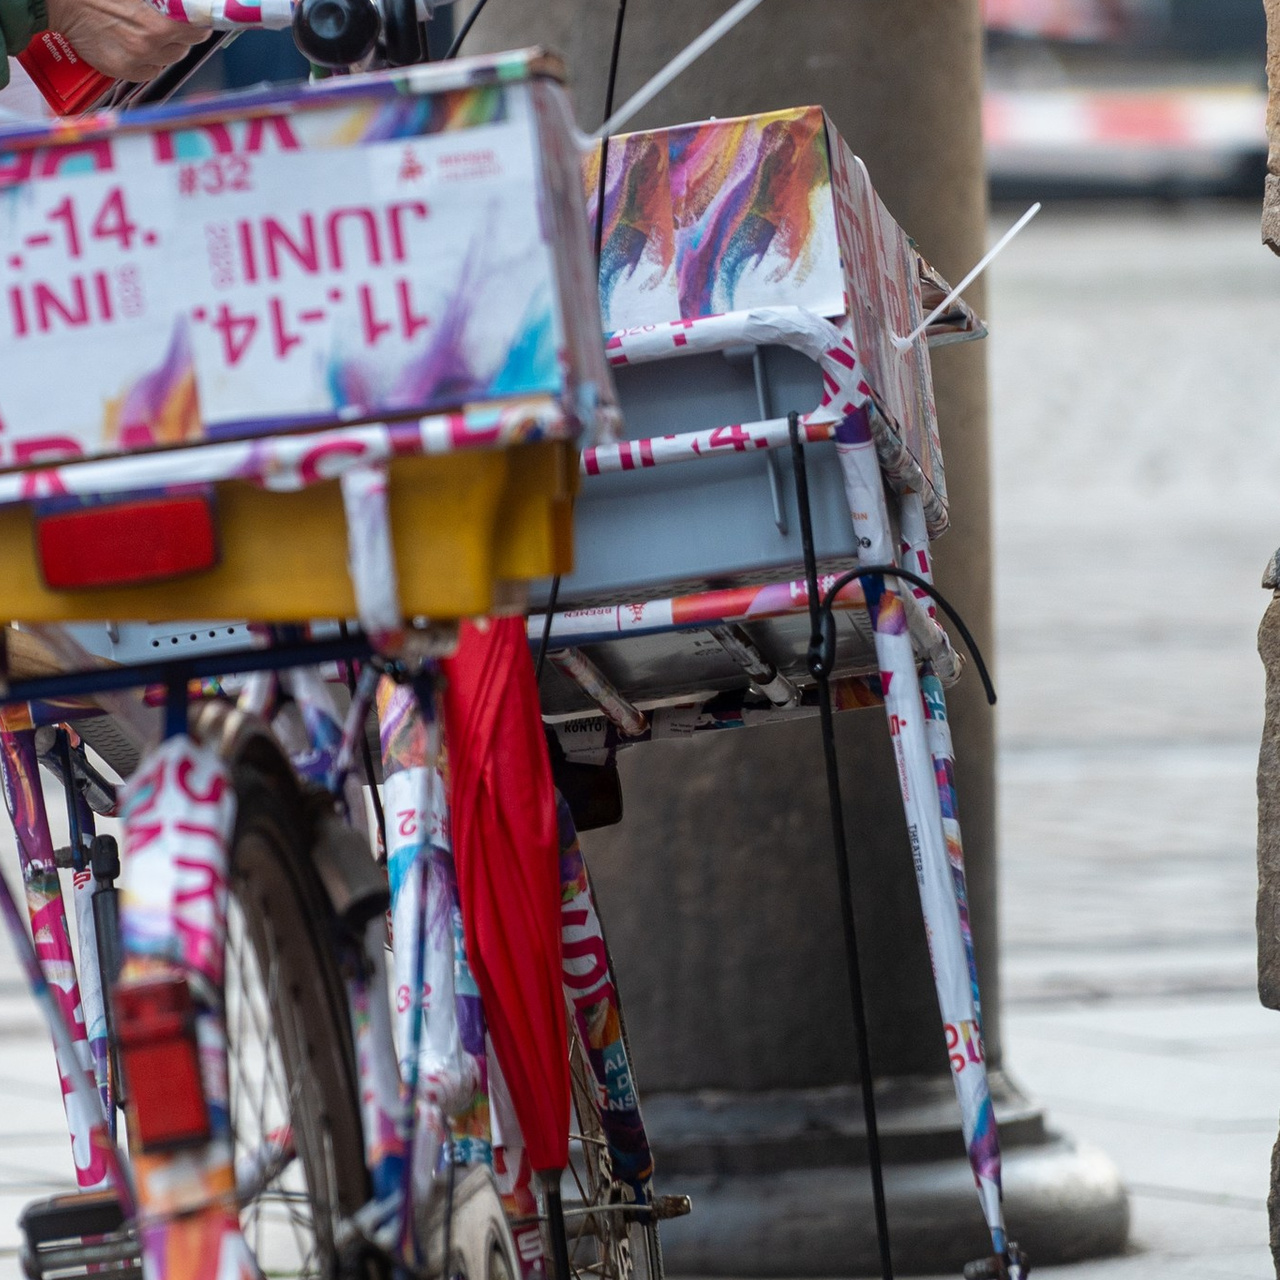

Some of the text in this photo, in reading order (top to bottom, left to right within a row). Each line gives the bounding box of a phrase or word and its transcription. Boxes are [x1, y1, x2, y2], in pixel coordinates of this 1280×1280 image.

[41, 33, 63, 62] Bremen
[177, 156, 254, 197] #32
[237, 201, 431, 285] JUNI
[191, 278, 431, 367] 11.-14.
[564, 607, 613, 620] BREMEN
[907, 822, 924, 872] THEATER
